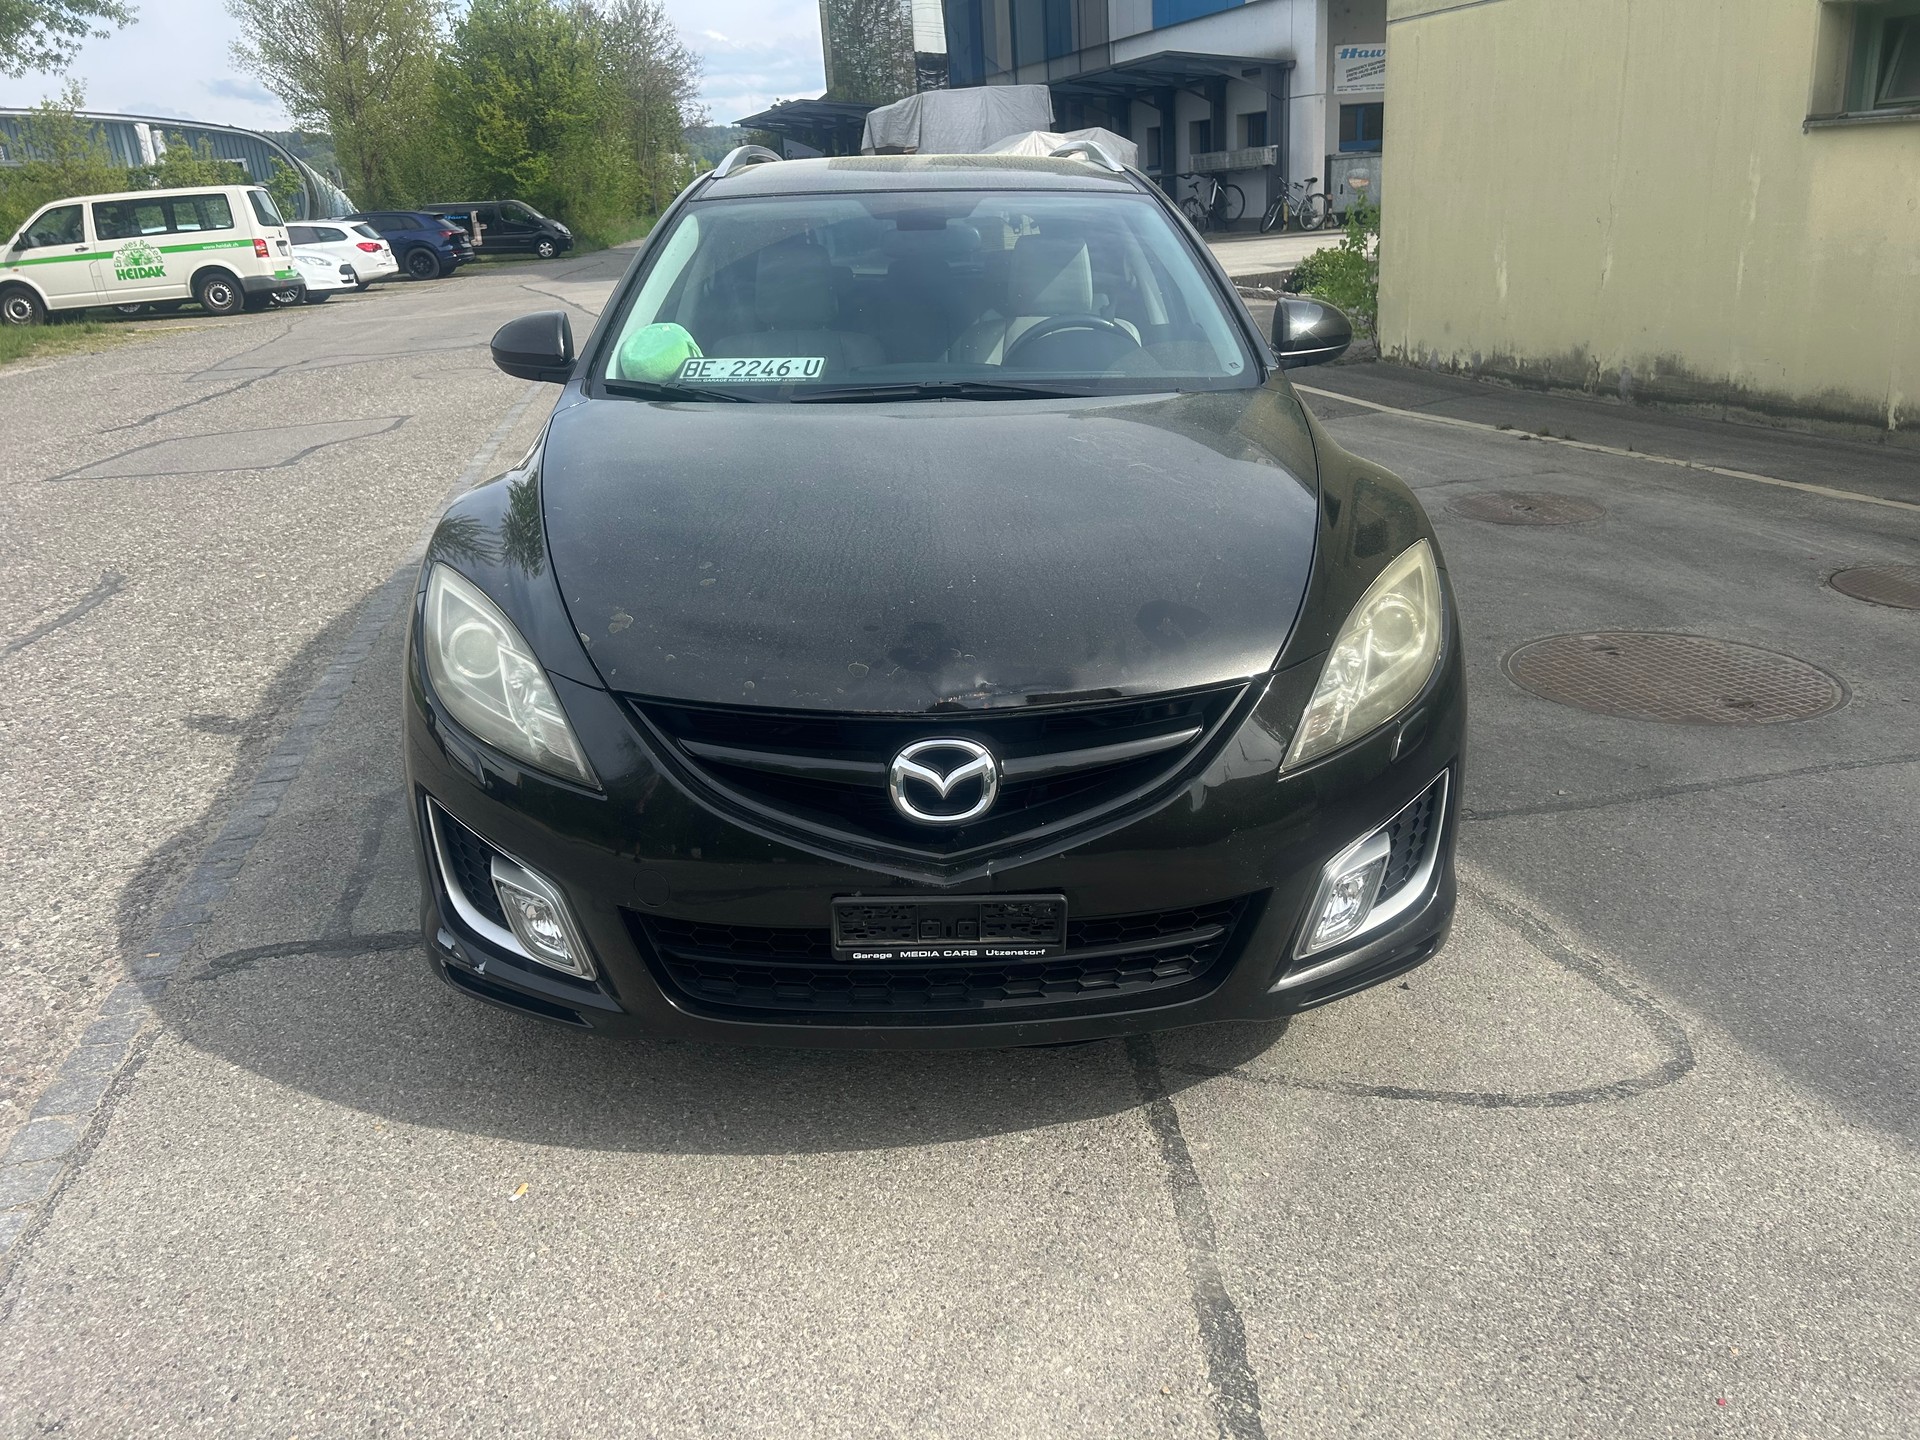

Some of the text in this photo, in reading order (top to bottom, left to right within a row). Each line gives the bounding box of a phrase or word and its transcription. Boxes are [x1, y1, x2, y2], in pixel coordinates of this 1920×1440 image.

[117, 241, 137, 257] gutes
[115, 266, 167, 281] HEIDAK
[853, 952, 893, 960] Garage
[900, 950, 940, 958] MEDIA
